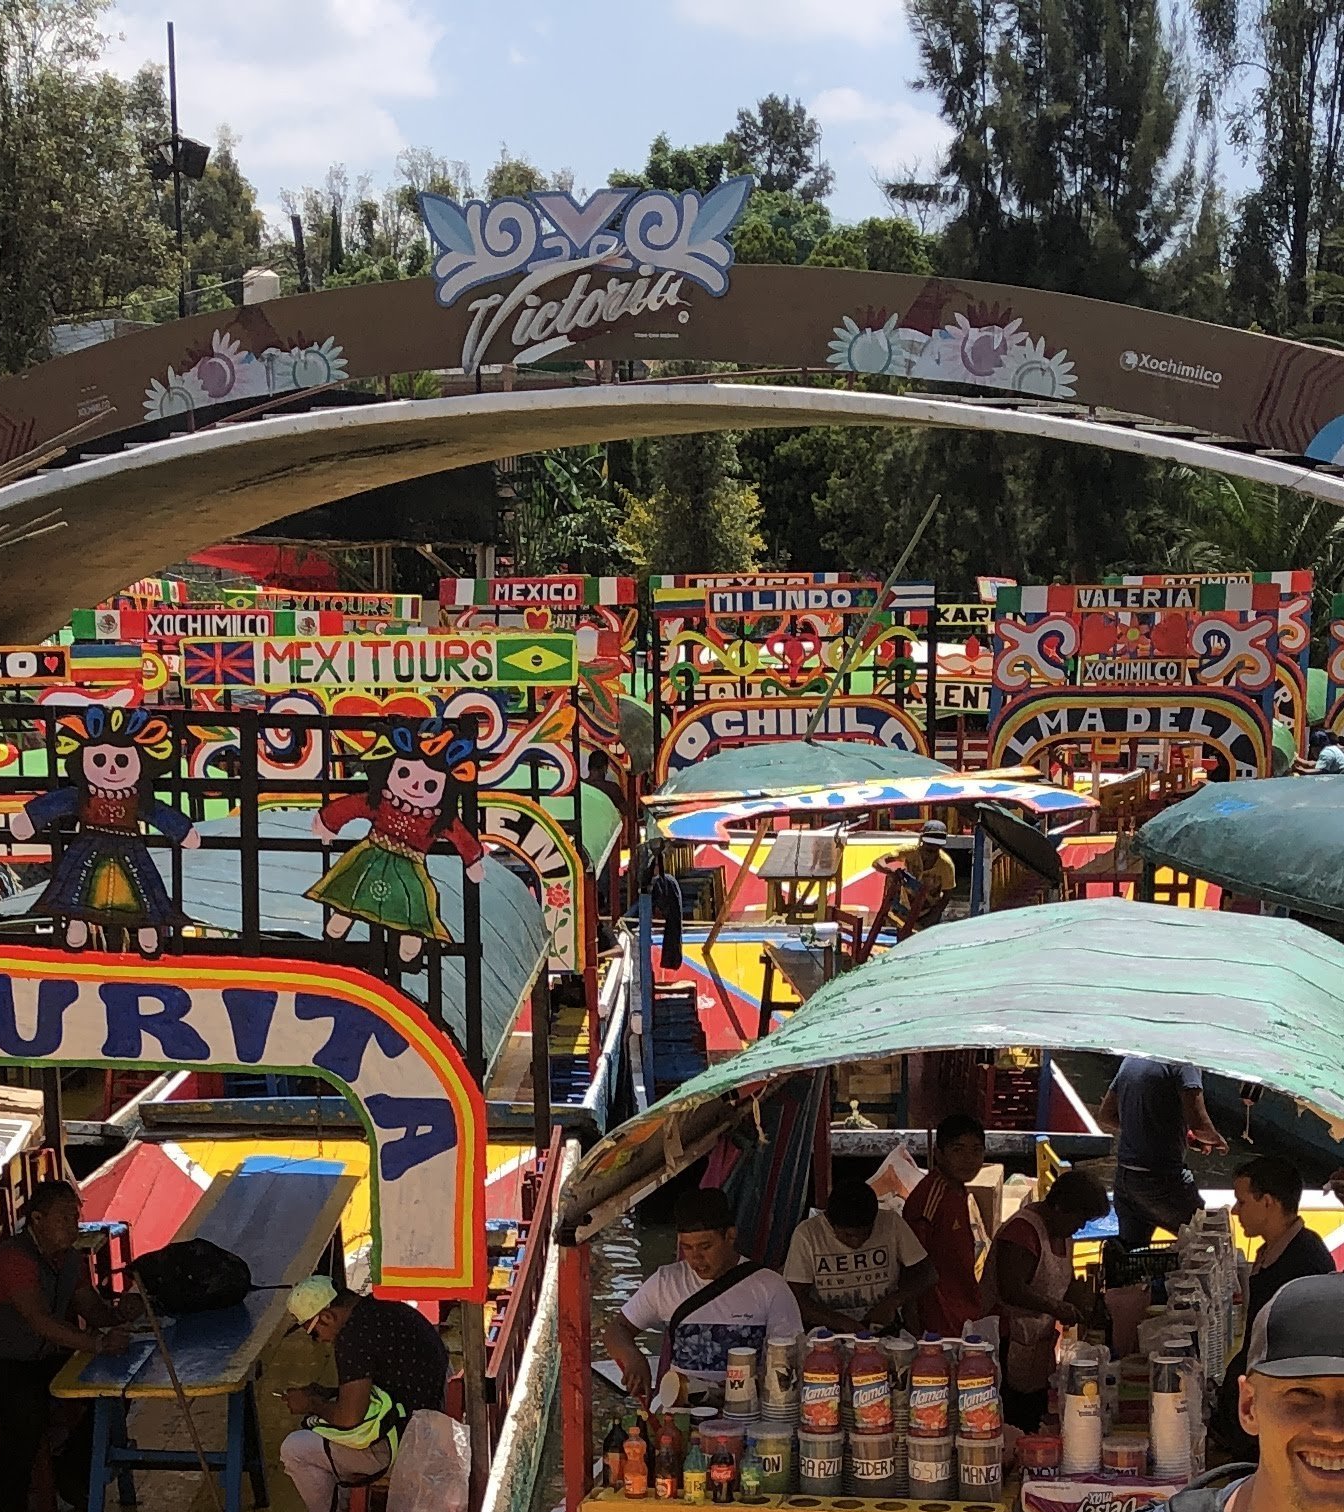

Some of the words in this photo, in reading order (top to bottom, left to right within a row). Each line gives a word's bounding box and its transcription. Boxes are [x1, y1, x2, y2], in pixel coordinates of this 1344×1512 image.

[461, 242, 692, 377] Victoria
[1139, 353, 1223, 384] Xochimilco
[494, 583, 577, 601] MEXICO
[714, 592, 743, 612] MI
[753, 589, 852, 611] LINDO
[1079, 588, 1194, 608] VALERIA
[147, 613, 269, 637] XOCHIMILCO
[263, 640, 493, 683] MEXITOURS
[1085, 660, 1179, 681] XOCHIMILCO
[817, 1249, 887, 1272] AERO
[1088, 1491, 1114, 1505] max
